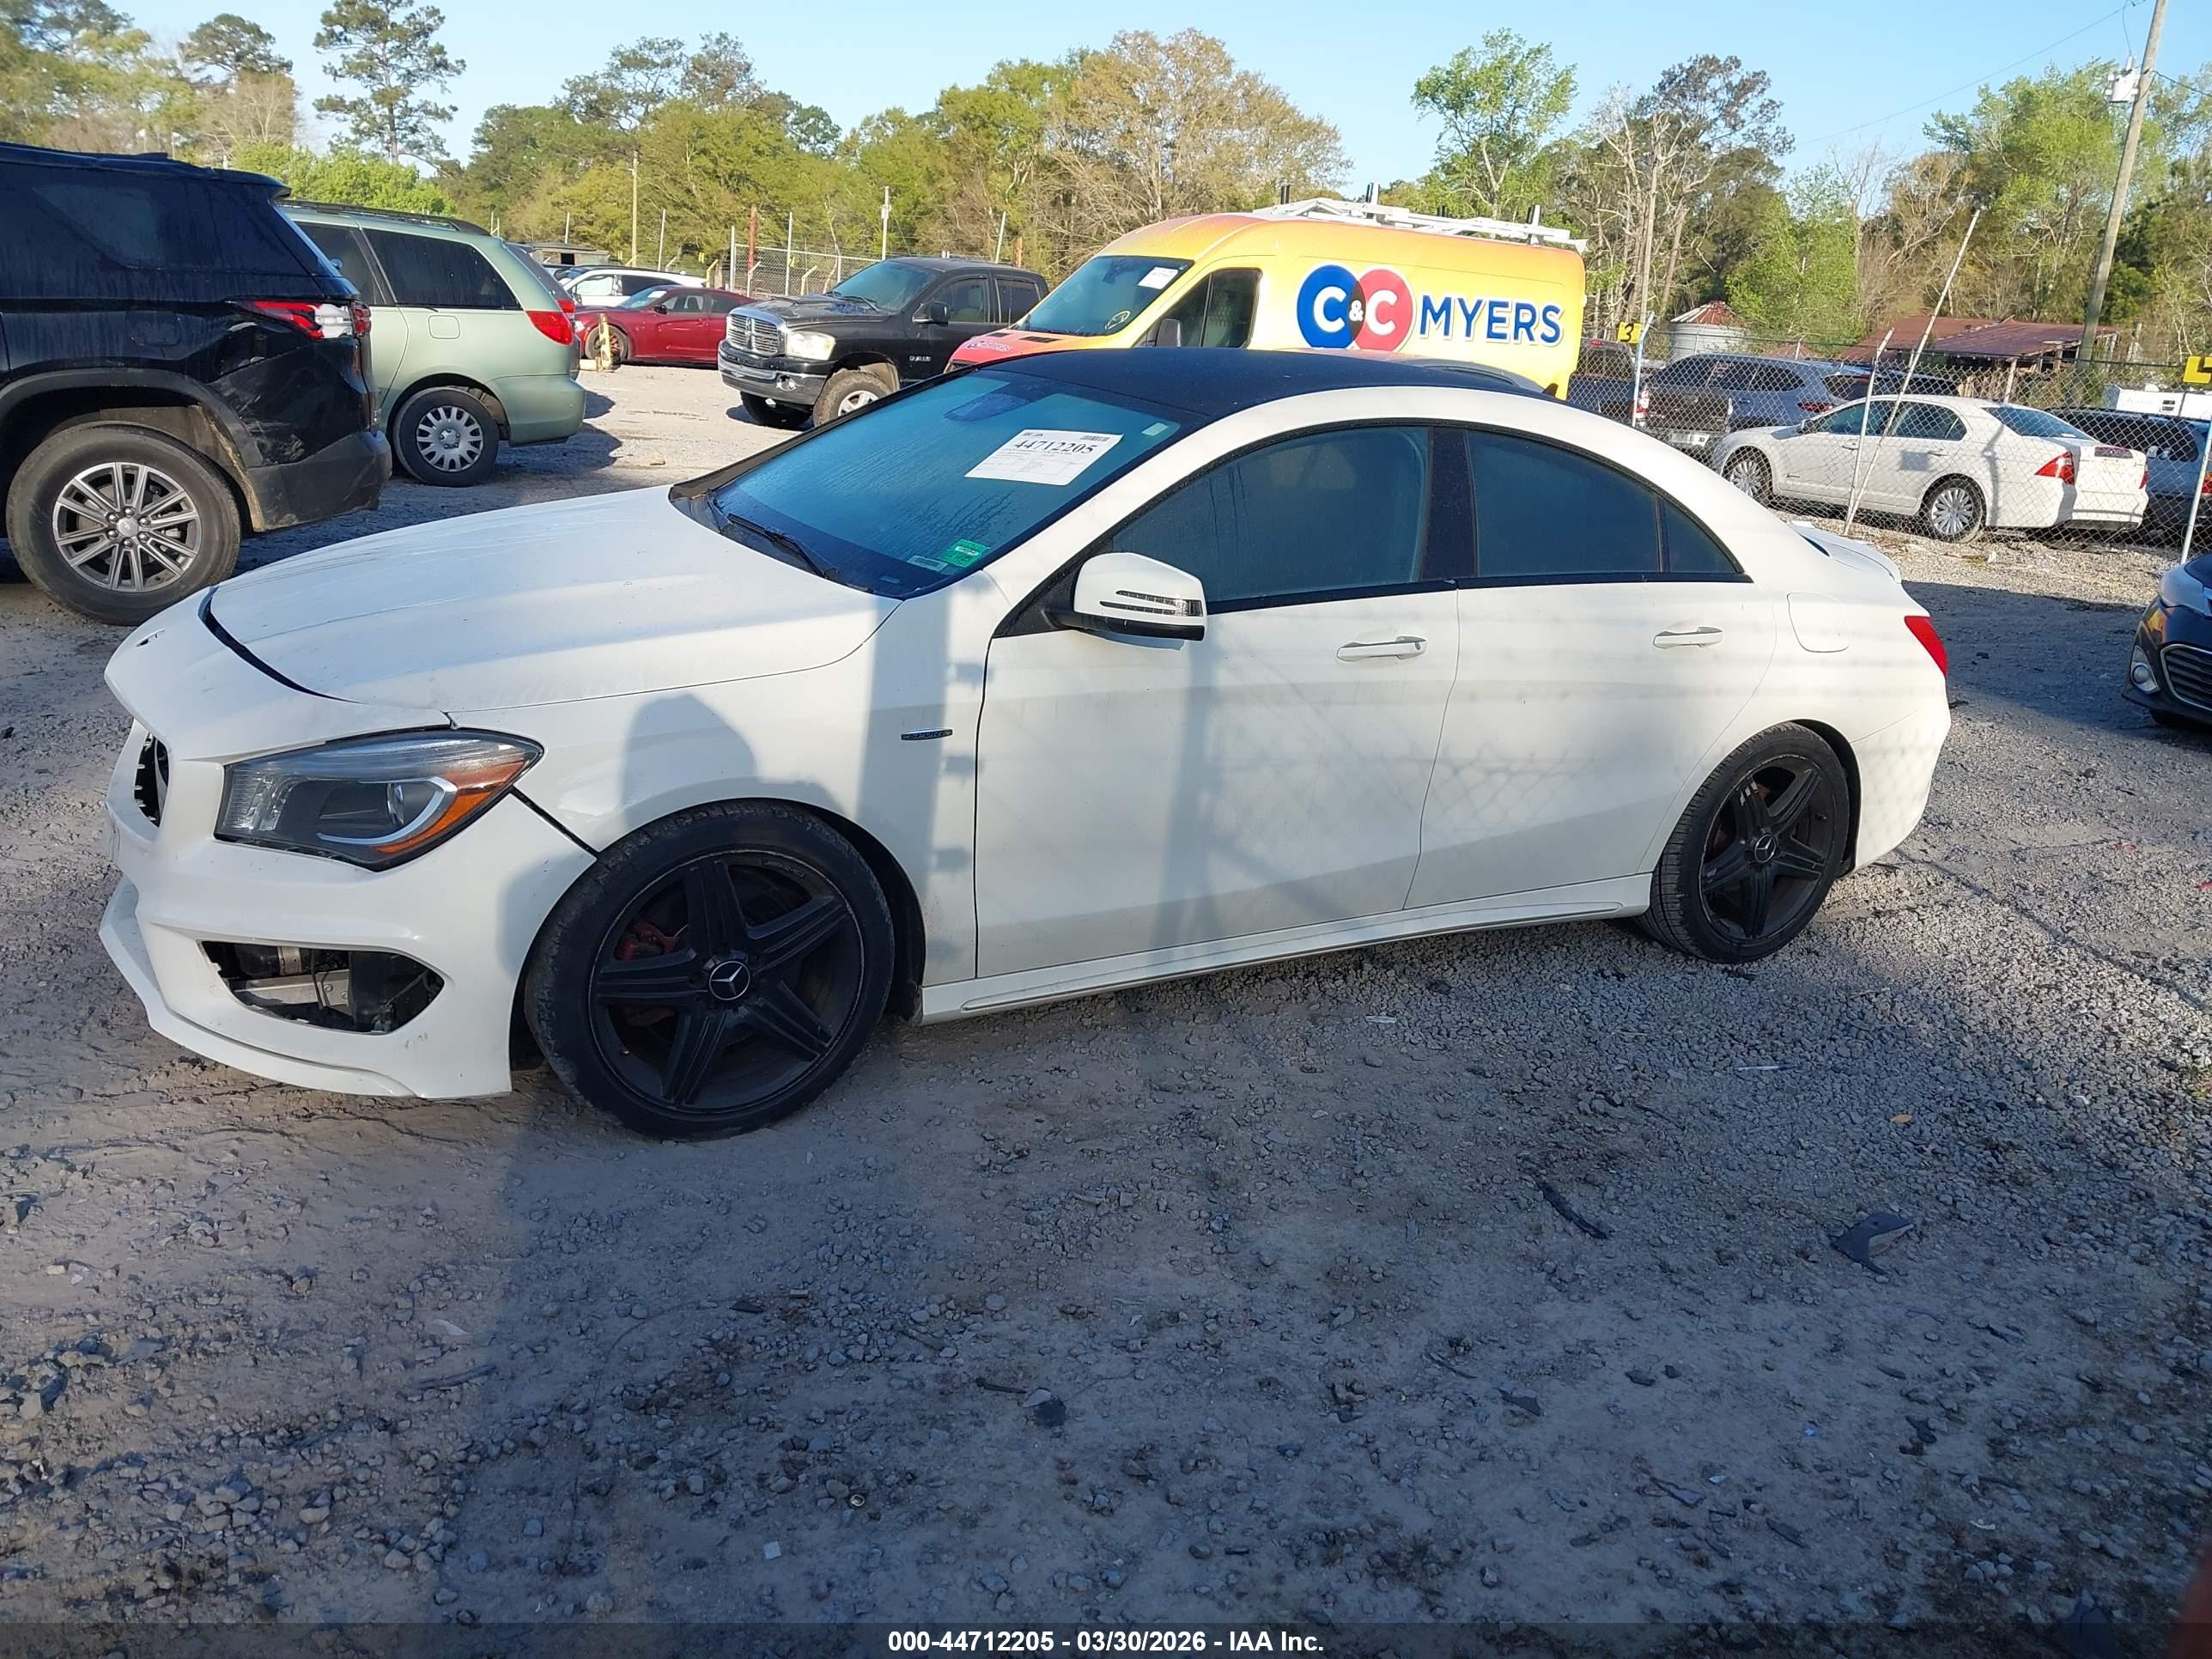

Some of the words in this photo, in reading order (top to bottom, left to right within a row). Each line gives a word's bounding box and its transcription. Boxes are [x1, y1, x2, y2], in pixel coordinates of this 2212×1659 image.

[1419, 295, 1562, 343] MYERS
[1620, 322, 1635, 343] 3
[1015, 440, 1098, 454] 44712205
